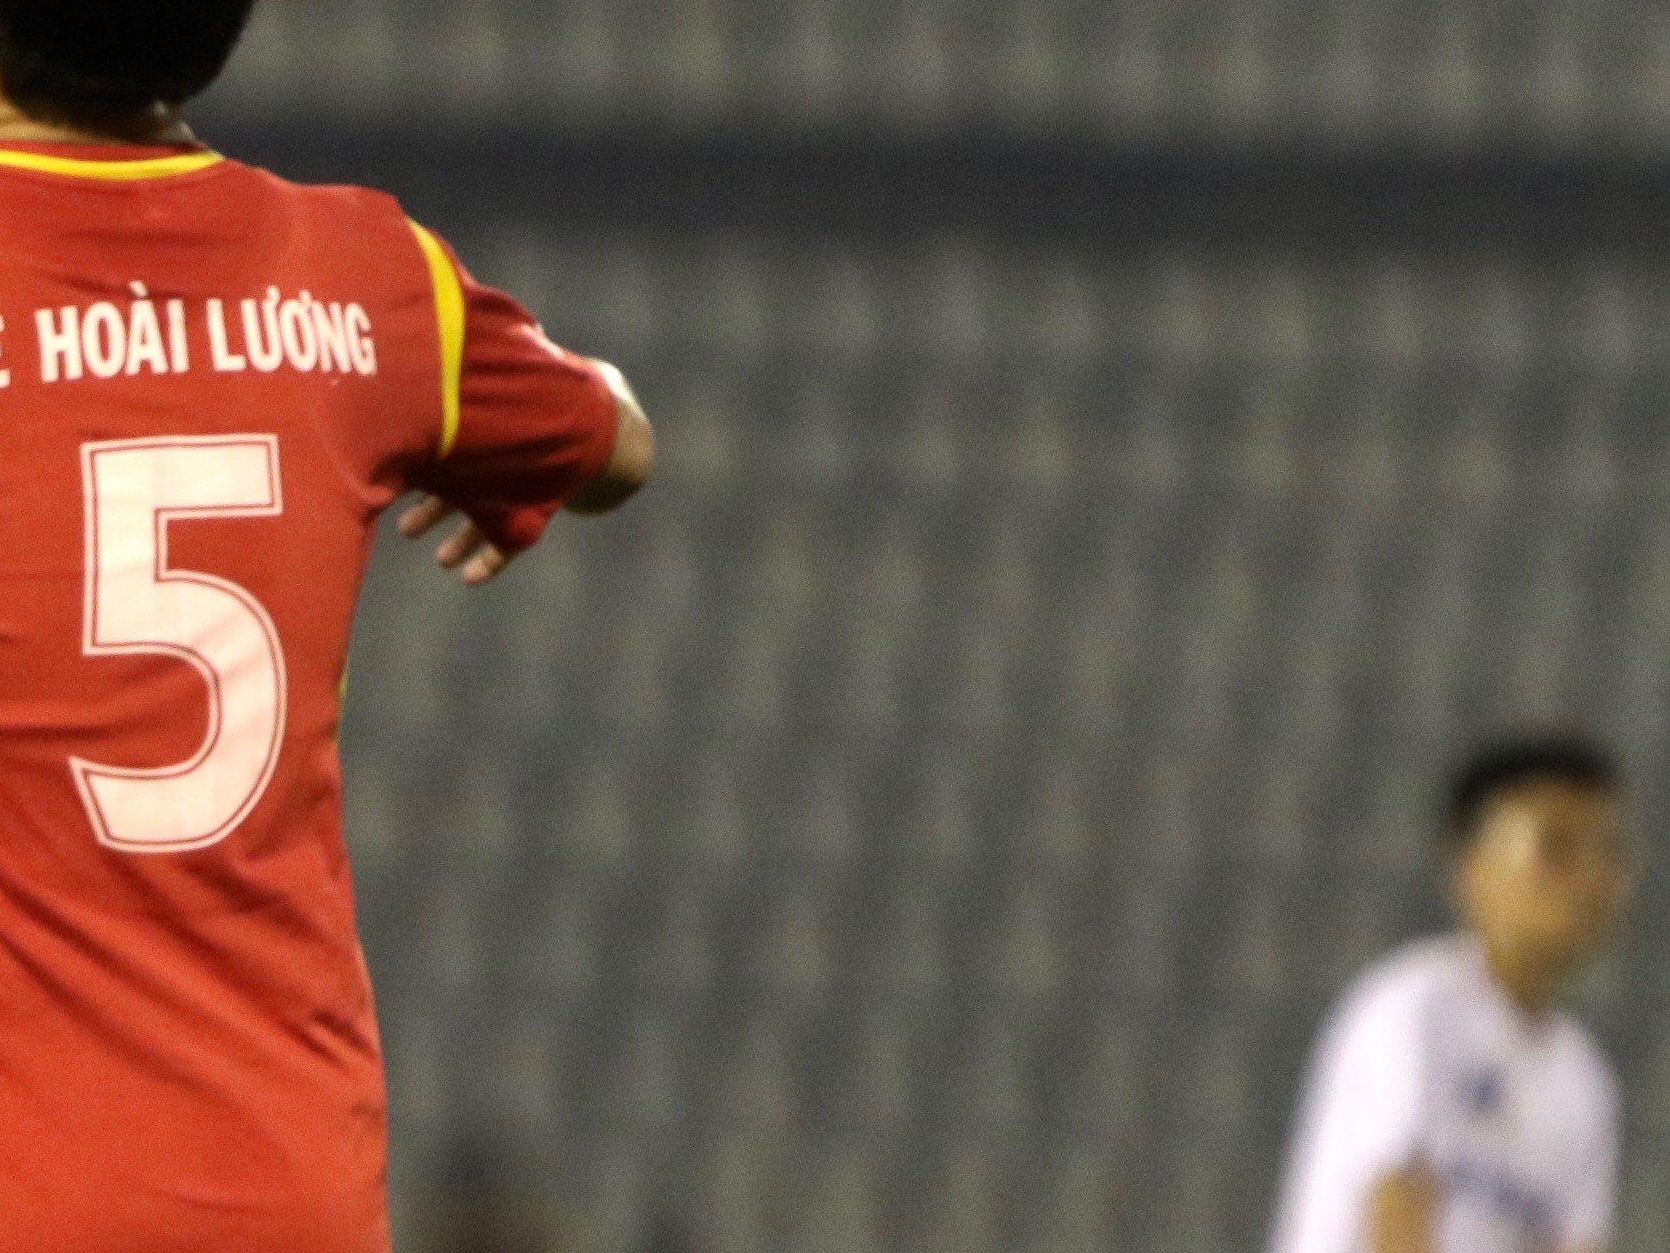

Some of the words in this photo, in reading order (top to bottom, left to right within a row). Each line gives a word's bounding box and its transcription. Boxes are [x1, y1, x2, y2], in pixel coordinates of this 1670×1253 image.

[34, 280, 190, 383] HOÀI
[206, 285, 378, 378] LƯƠNG
[68, 433, 287, 853] 5
